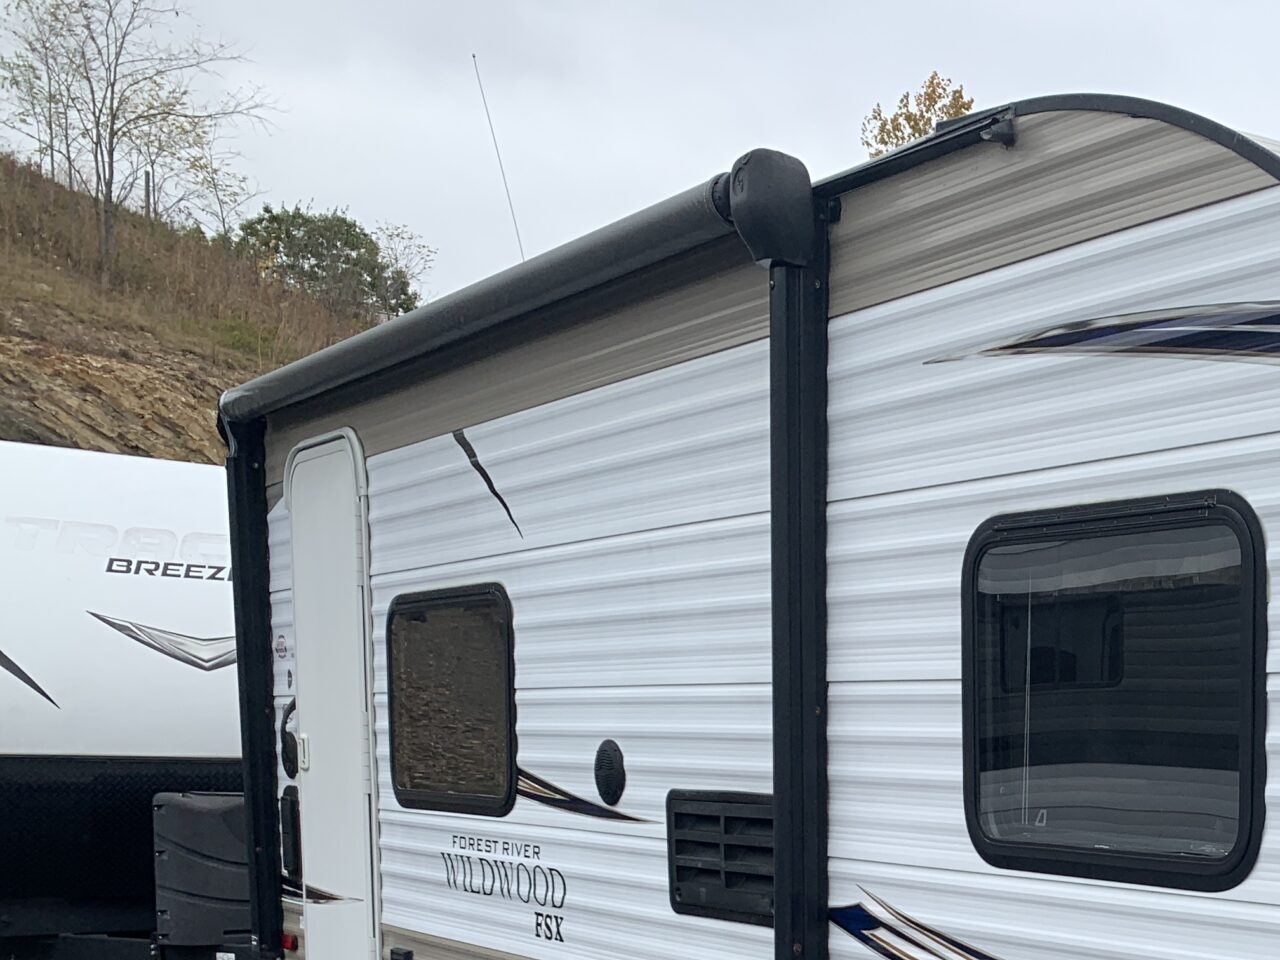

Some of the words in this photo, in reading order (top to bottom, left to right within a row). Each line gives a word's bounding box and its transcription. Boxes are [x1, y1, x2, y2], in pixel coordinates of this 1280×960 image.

[105, 557, 232, 582] BREEZ
[452, 835, 499, 854] FOREST
[502, 841, 541, 860] RIVER
[440, 851, 567, 909] WILDWOOD
[534, 911, 565, 943] FSX
